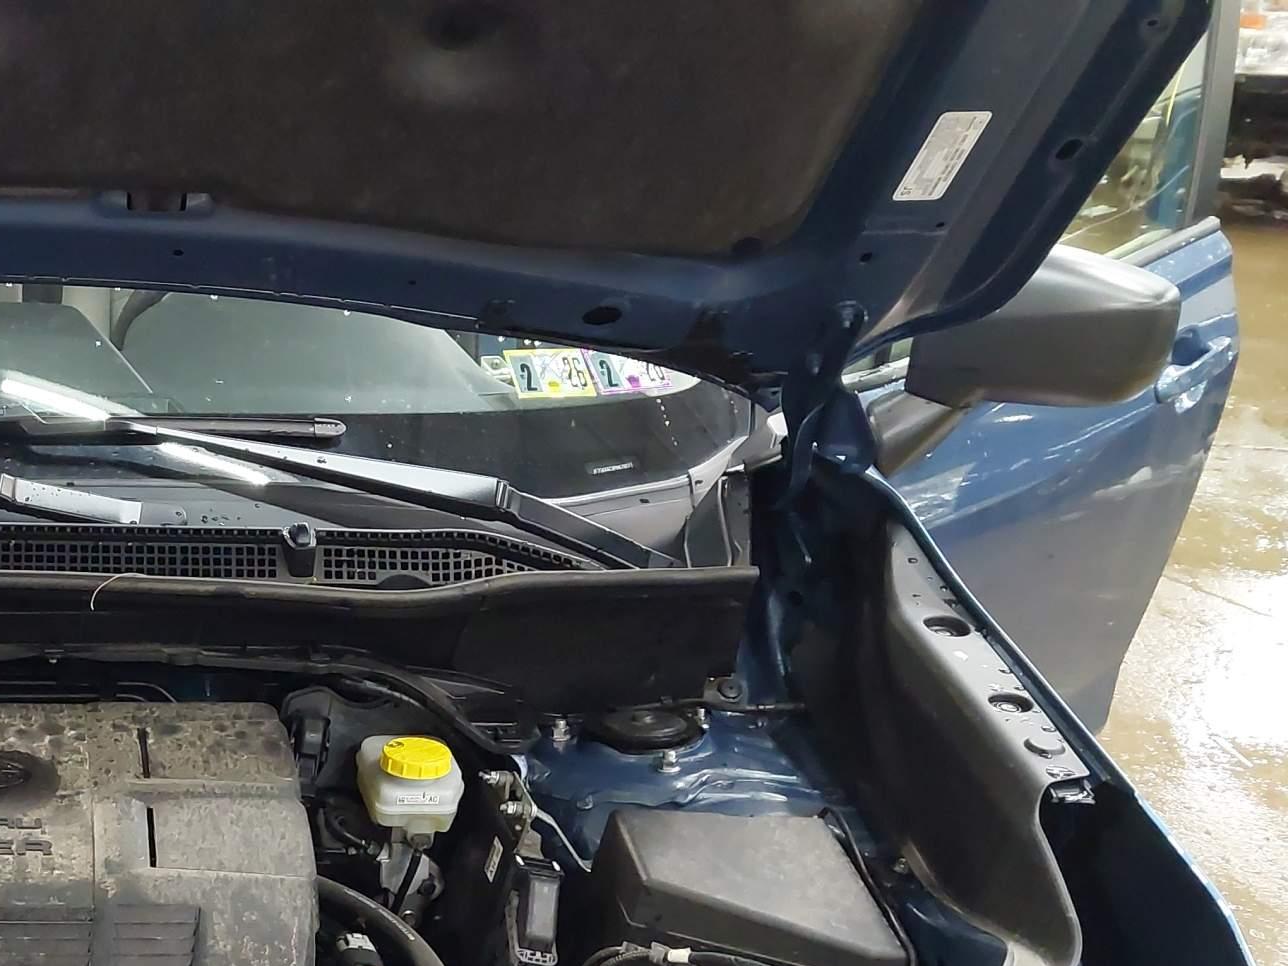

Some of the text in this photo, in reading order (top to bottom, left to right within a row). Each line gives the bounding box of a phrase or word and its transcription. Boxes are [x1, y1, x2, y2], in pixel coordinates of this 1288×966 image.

[519, 356, 588, 391] 2 26
[598, 359, 618, 387] 2
